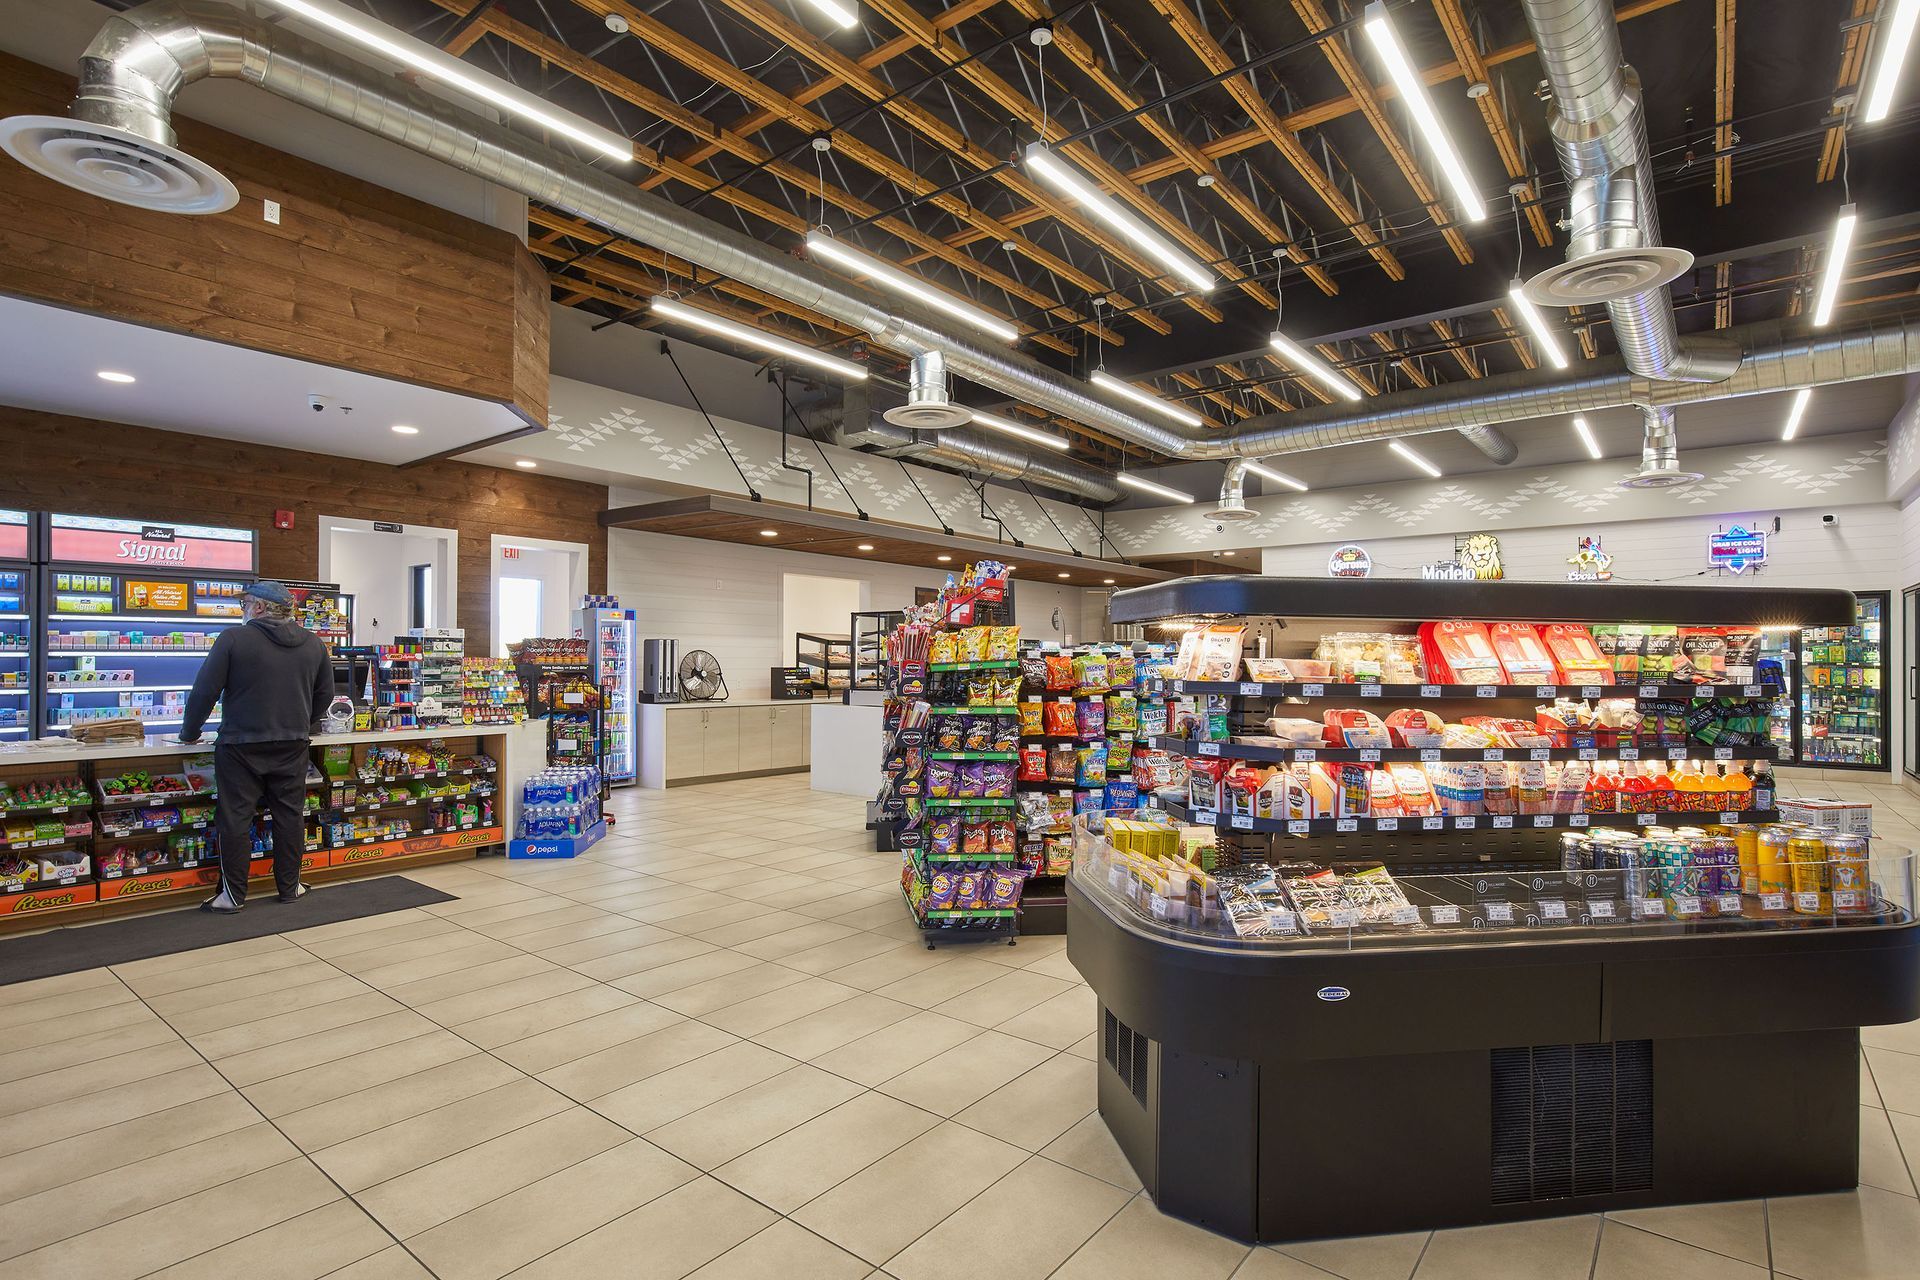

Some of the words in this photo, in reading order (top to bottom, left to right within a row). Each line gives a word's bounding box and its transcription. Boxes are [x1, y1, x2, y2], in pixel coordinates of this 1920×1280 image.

[116, 540, 188, 562] Signal
[504, 548, 520, 559] EXIT
[1331, 560, 1368, 572] Corona
[1422, 565, 1476, 580] Modelo
[1568, 572, 1598, 580] Coors
[1454, 621, 1473, 629] OLLI
[1511, 624, 1530, 632] OLLI
[1144, 710, 1167, 719] Welch's
[538, 821, 564, 829] AQUAFINA
[990, 828, 1014, 837] Doritos
[456, 832, 491, 845] Reese's
[345, 848, 384, 862] Reese's
[0, 878, 22, 886] POPS
[119, 878, 174, 895] Reese's
[13, 894, 74, 912] Reese's
